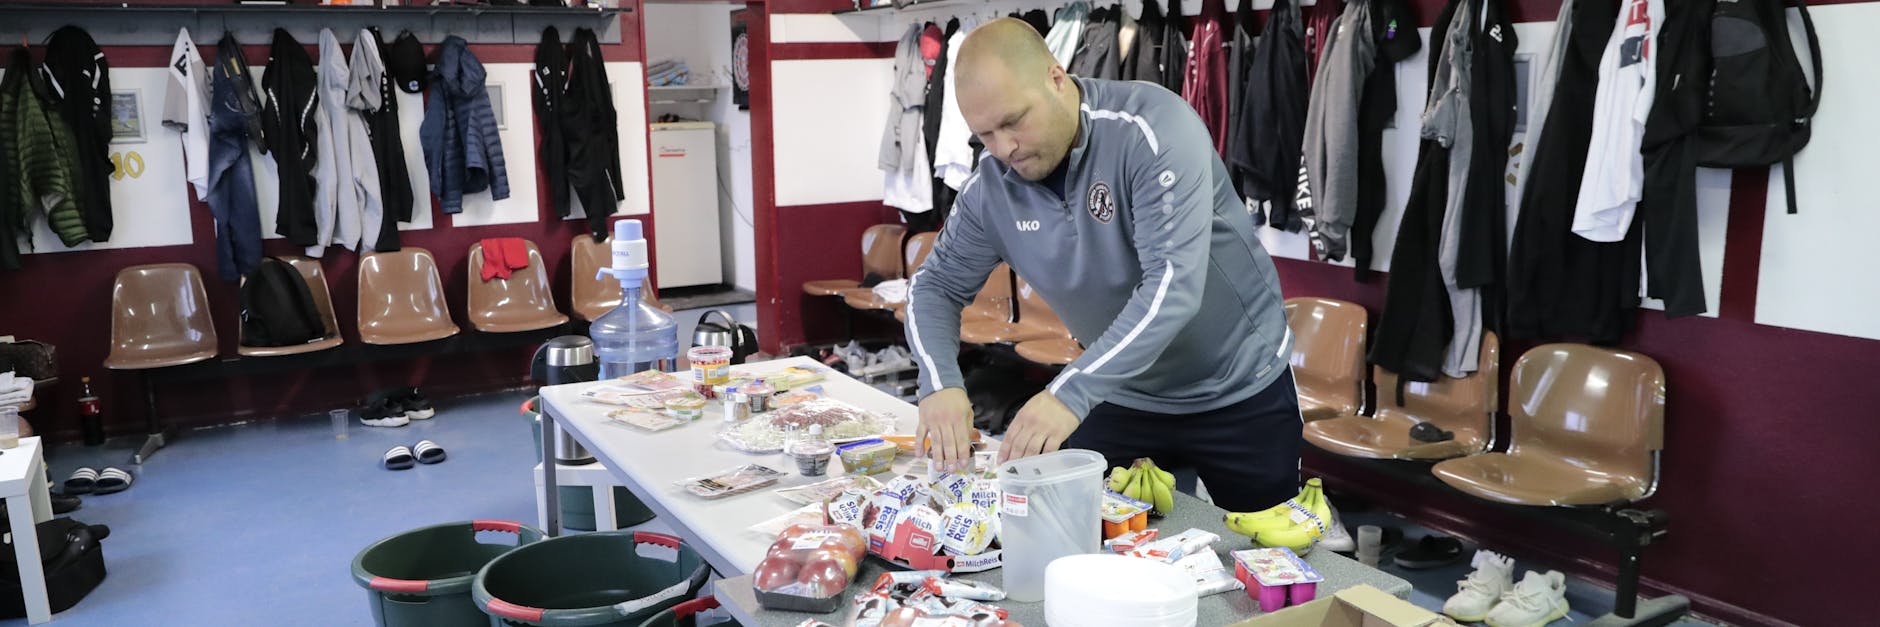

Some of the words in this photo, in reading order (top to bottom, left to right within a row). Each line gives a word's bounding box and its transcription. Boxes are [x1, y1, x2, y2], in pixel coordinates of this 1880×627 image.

[971, 491, 997, 499] Milch
[875, 505, 893, 531] Reis
[946, 514, 963, 538] Milch
[953, 517, 973, 542] Reis
[965, 556, 998, 568] MilchReis
